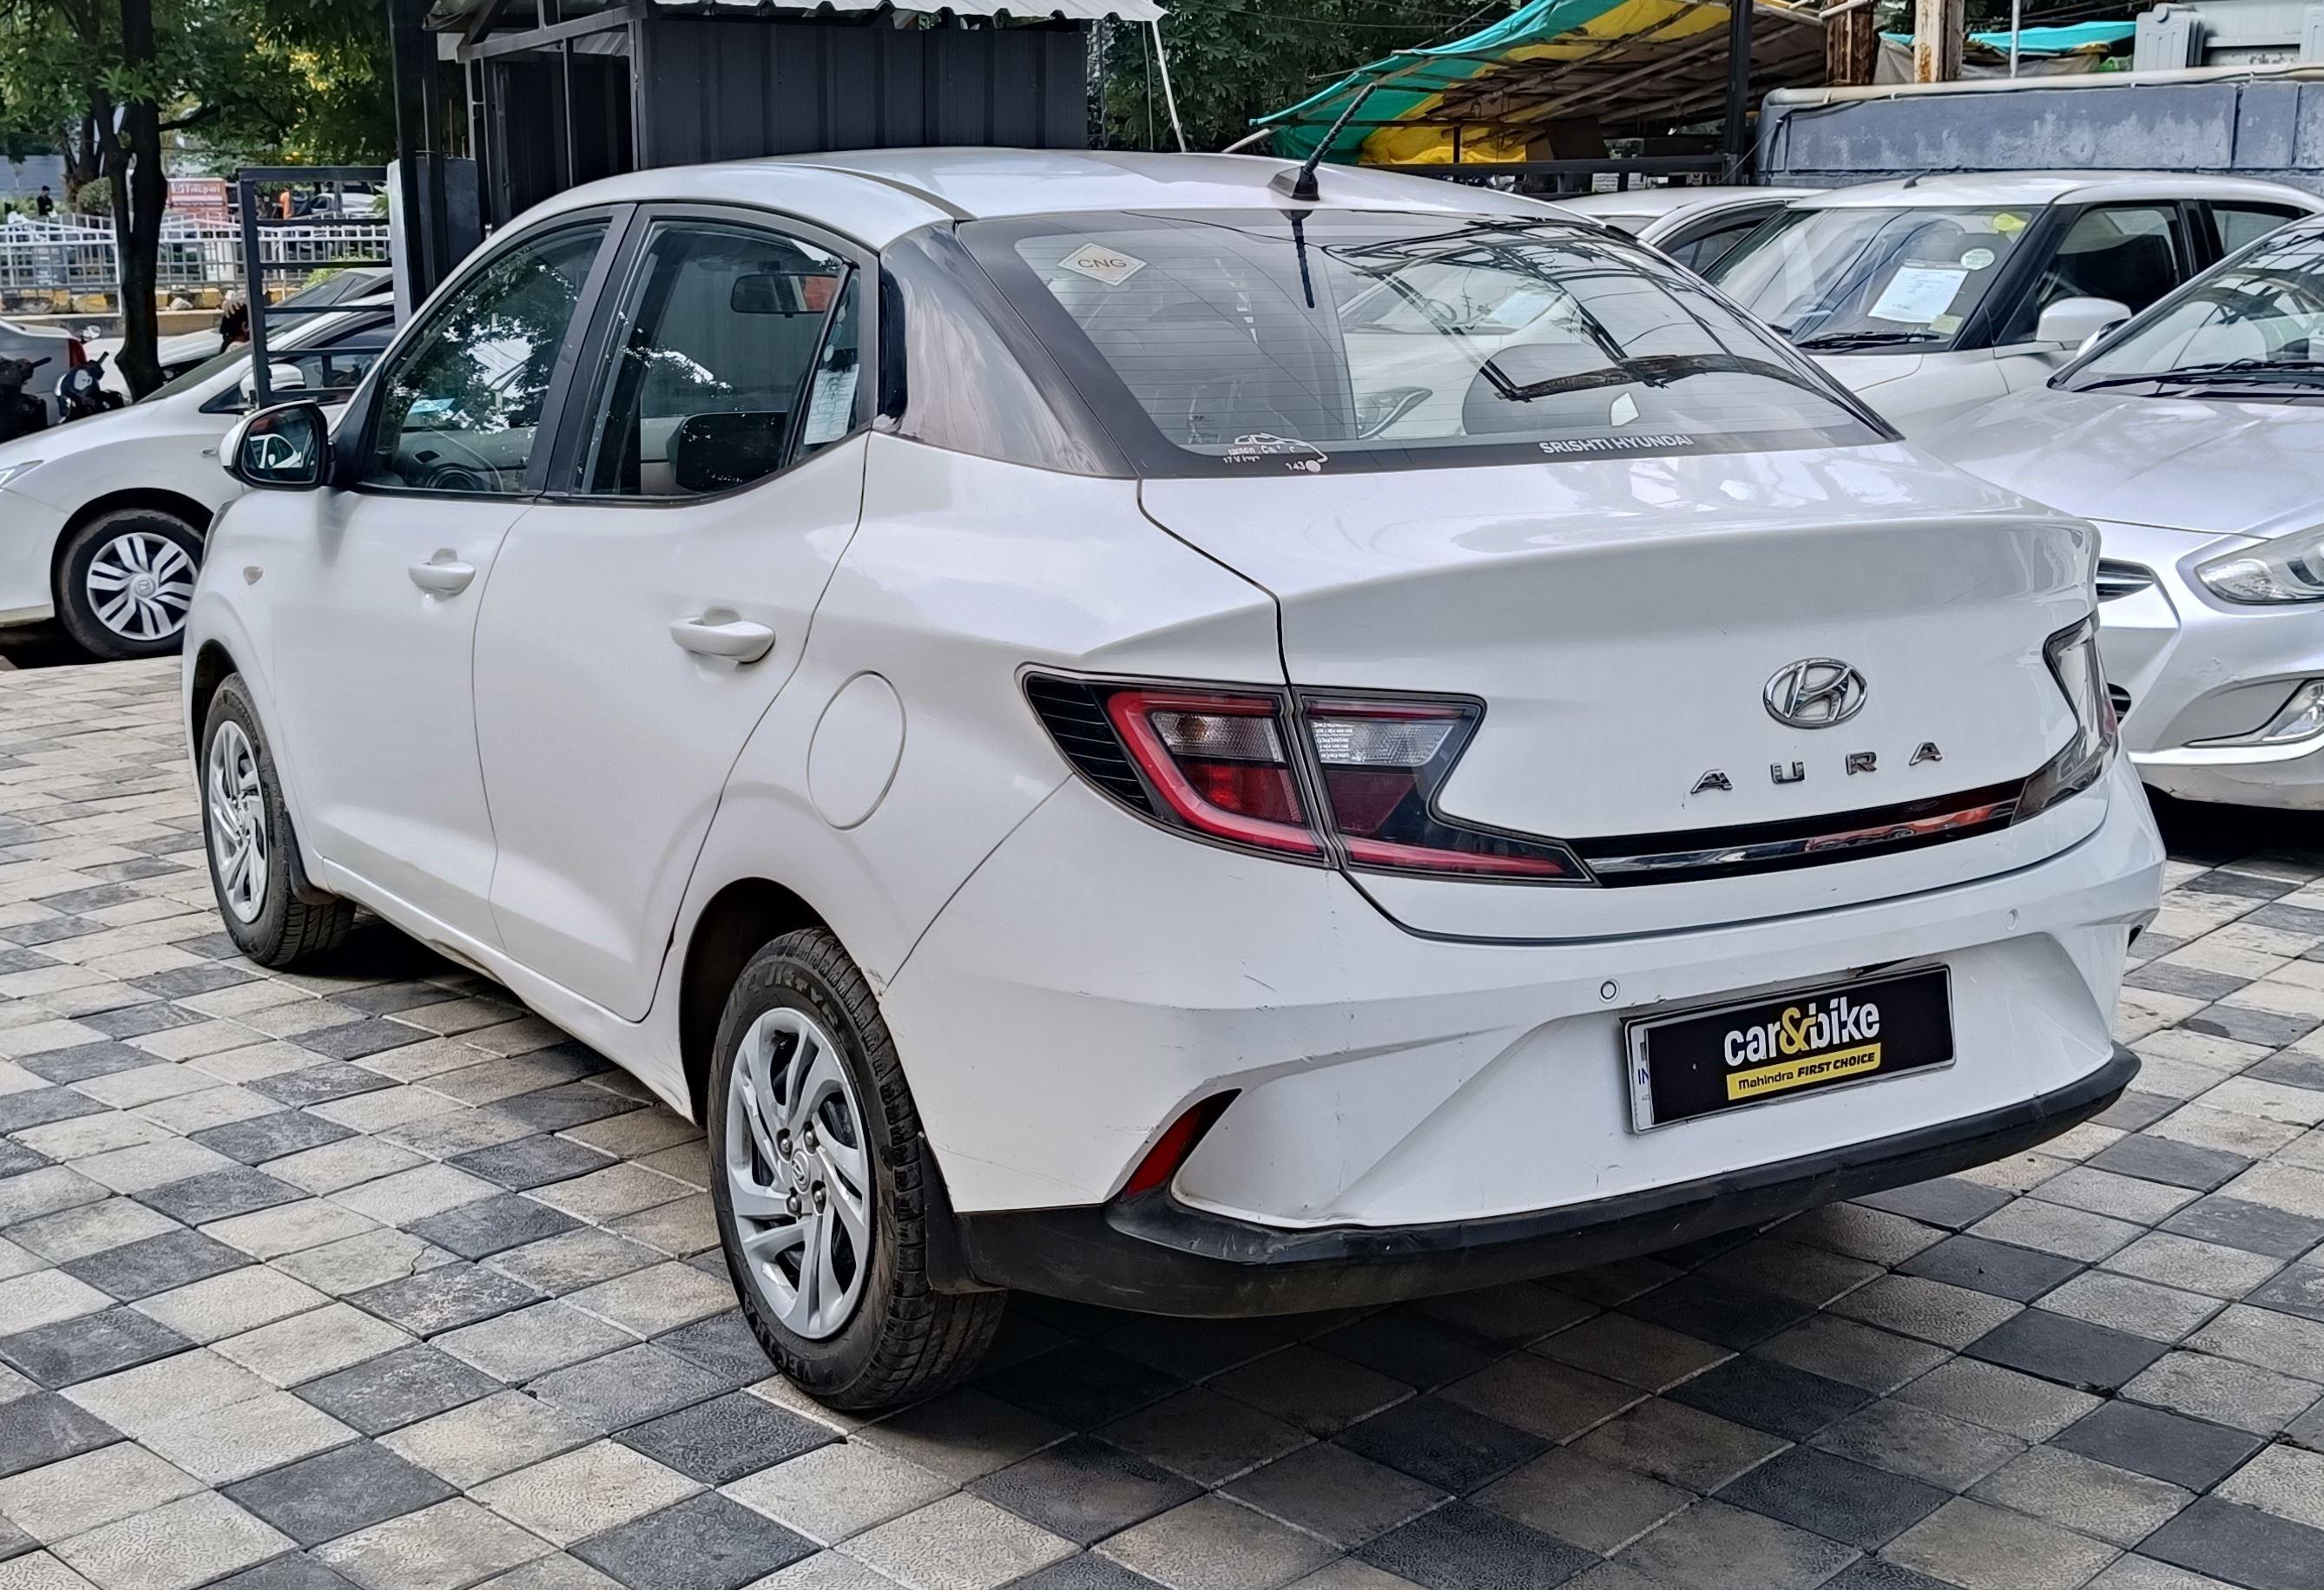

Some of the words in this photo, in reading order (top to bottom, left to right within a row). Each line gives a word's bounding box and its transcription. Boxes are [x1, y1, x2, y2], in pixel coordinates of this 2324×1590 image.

[1077, 259, 1127, 268] CNG
[1538, 438, 1614, 454] SRISHTI
[1610, 434, 1695, 450] HYUNDAI
[1690, 740, 1945, 794] AURA
[1724, 995, 1880, 1067] car&bike
[1738, 1070, 1794, 1090] Mahindra
[1797, 1061, 1832, 1078] FIRST
[1833, 1052, 1875, 1070] CHOICE
